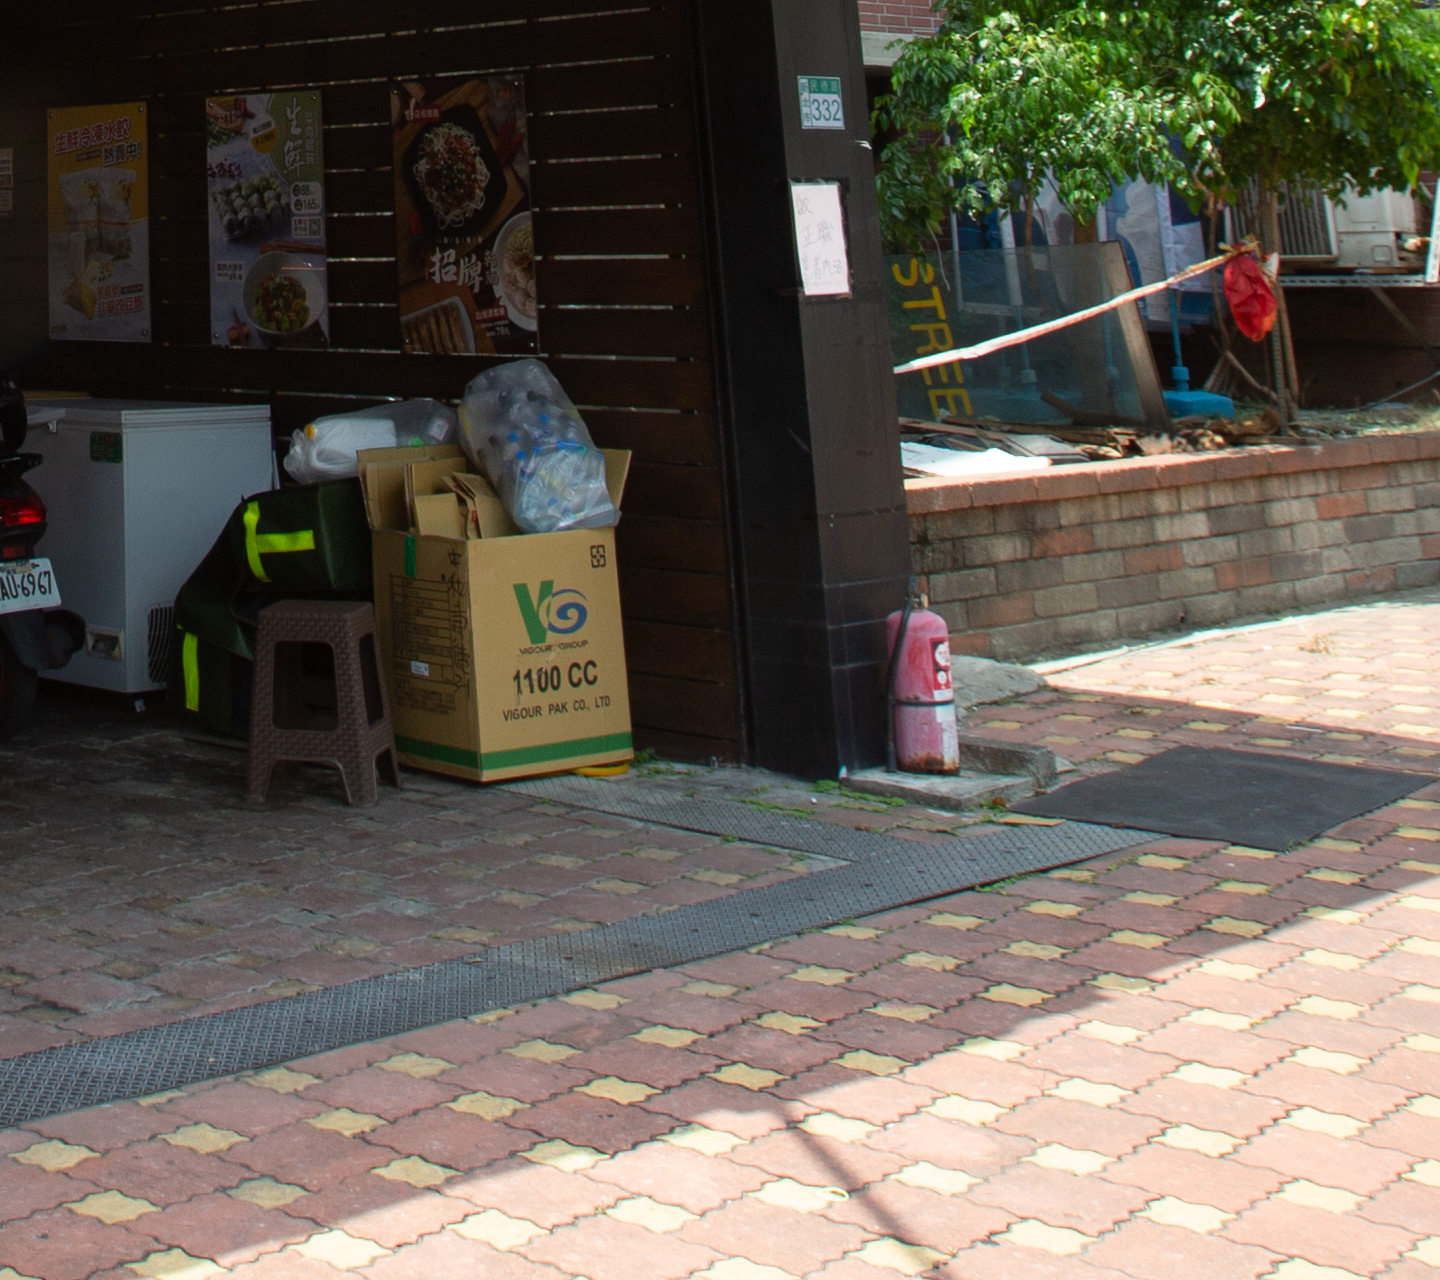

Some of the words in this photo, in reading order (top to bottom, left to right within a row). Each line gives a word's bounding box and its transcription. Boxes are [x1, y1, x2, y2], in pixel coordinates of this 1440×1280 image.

[812, 99, 841, 121] 332
[54, 116, 131, 154] 生鮮冷凍水餃
[429, 246, 483, 293] 招牌
[513, 664, 560, 695] 1100
[569, 660, 598, 688] CC
[502, 705, 542, 721] VIGOUR
[549, 701, 568, 715] PAK
[595, 695, 611, 708] LTD
